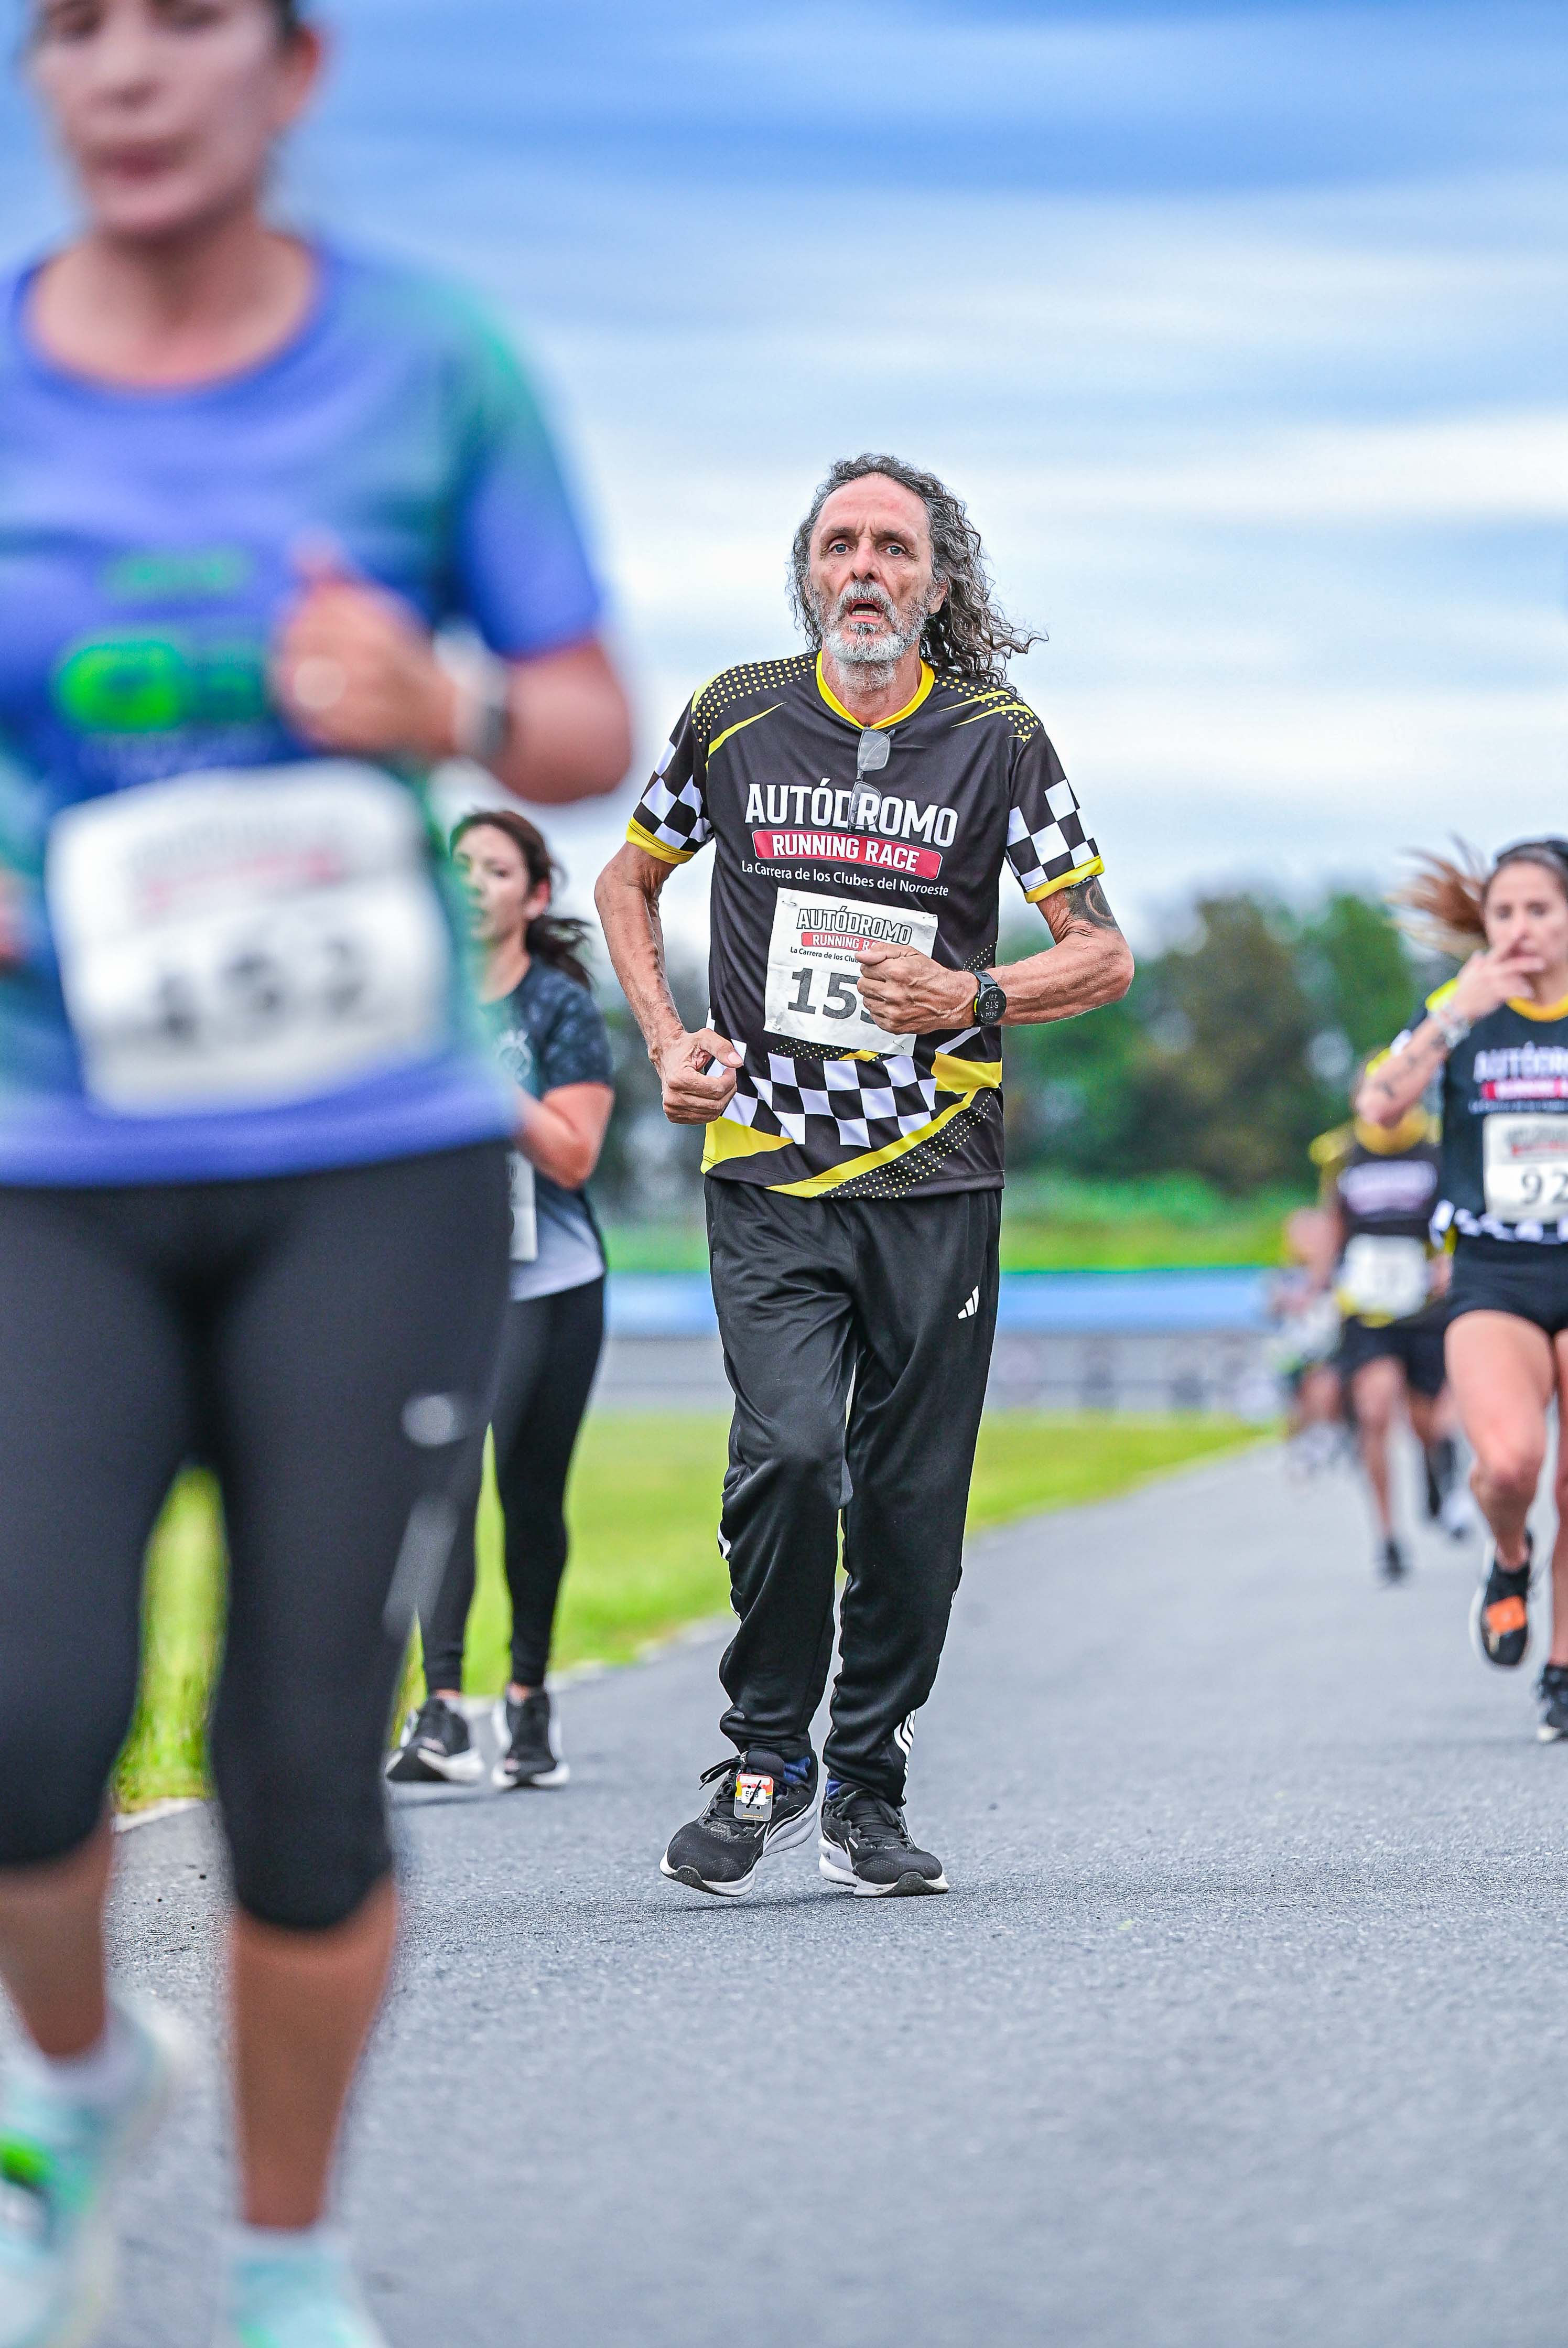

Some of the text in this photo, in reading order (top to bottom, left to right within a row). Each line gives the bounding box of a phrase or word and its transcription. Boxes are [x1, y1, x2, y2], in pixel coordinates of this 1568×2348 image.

[744, 777, 959, 848] AUTÓDROMO
[772, 834, 920, 873] RUNNING RACE
[741, 859, 949, 897] La Carrera de los Clubes del Noroeste
[796, 906, 913, 945] AUTÓDROMO
[812, 934, 860, 949] RUNNING
[798, 948, 822, 957] Carrera
[787, 967, 877, 1025] 15
